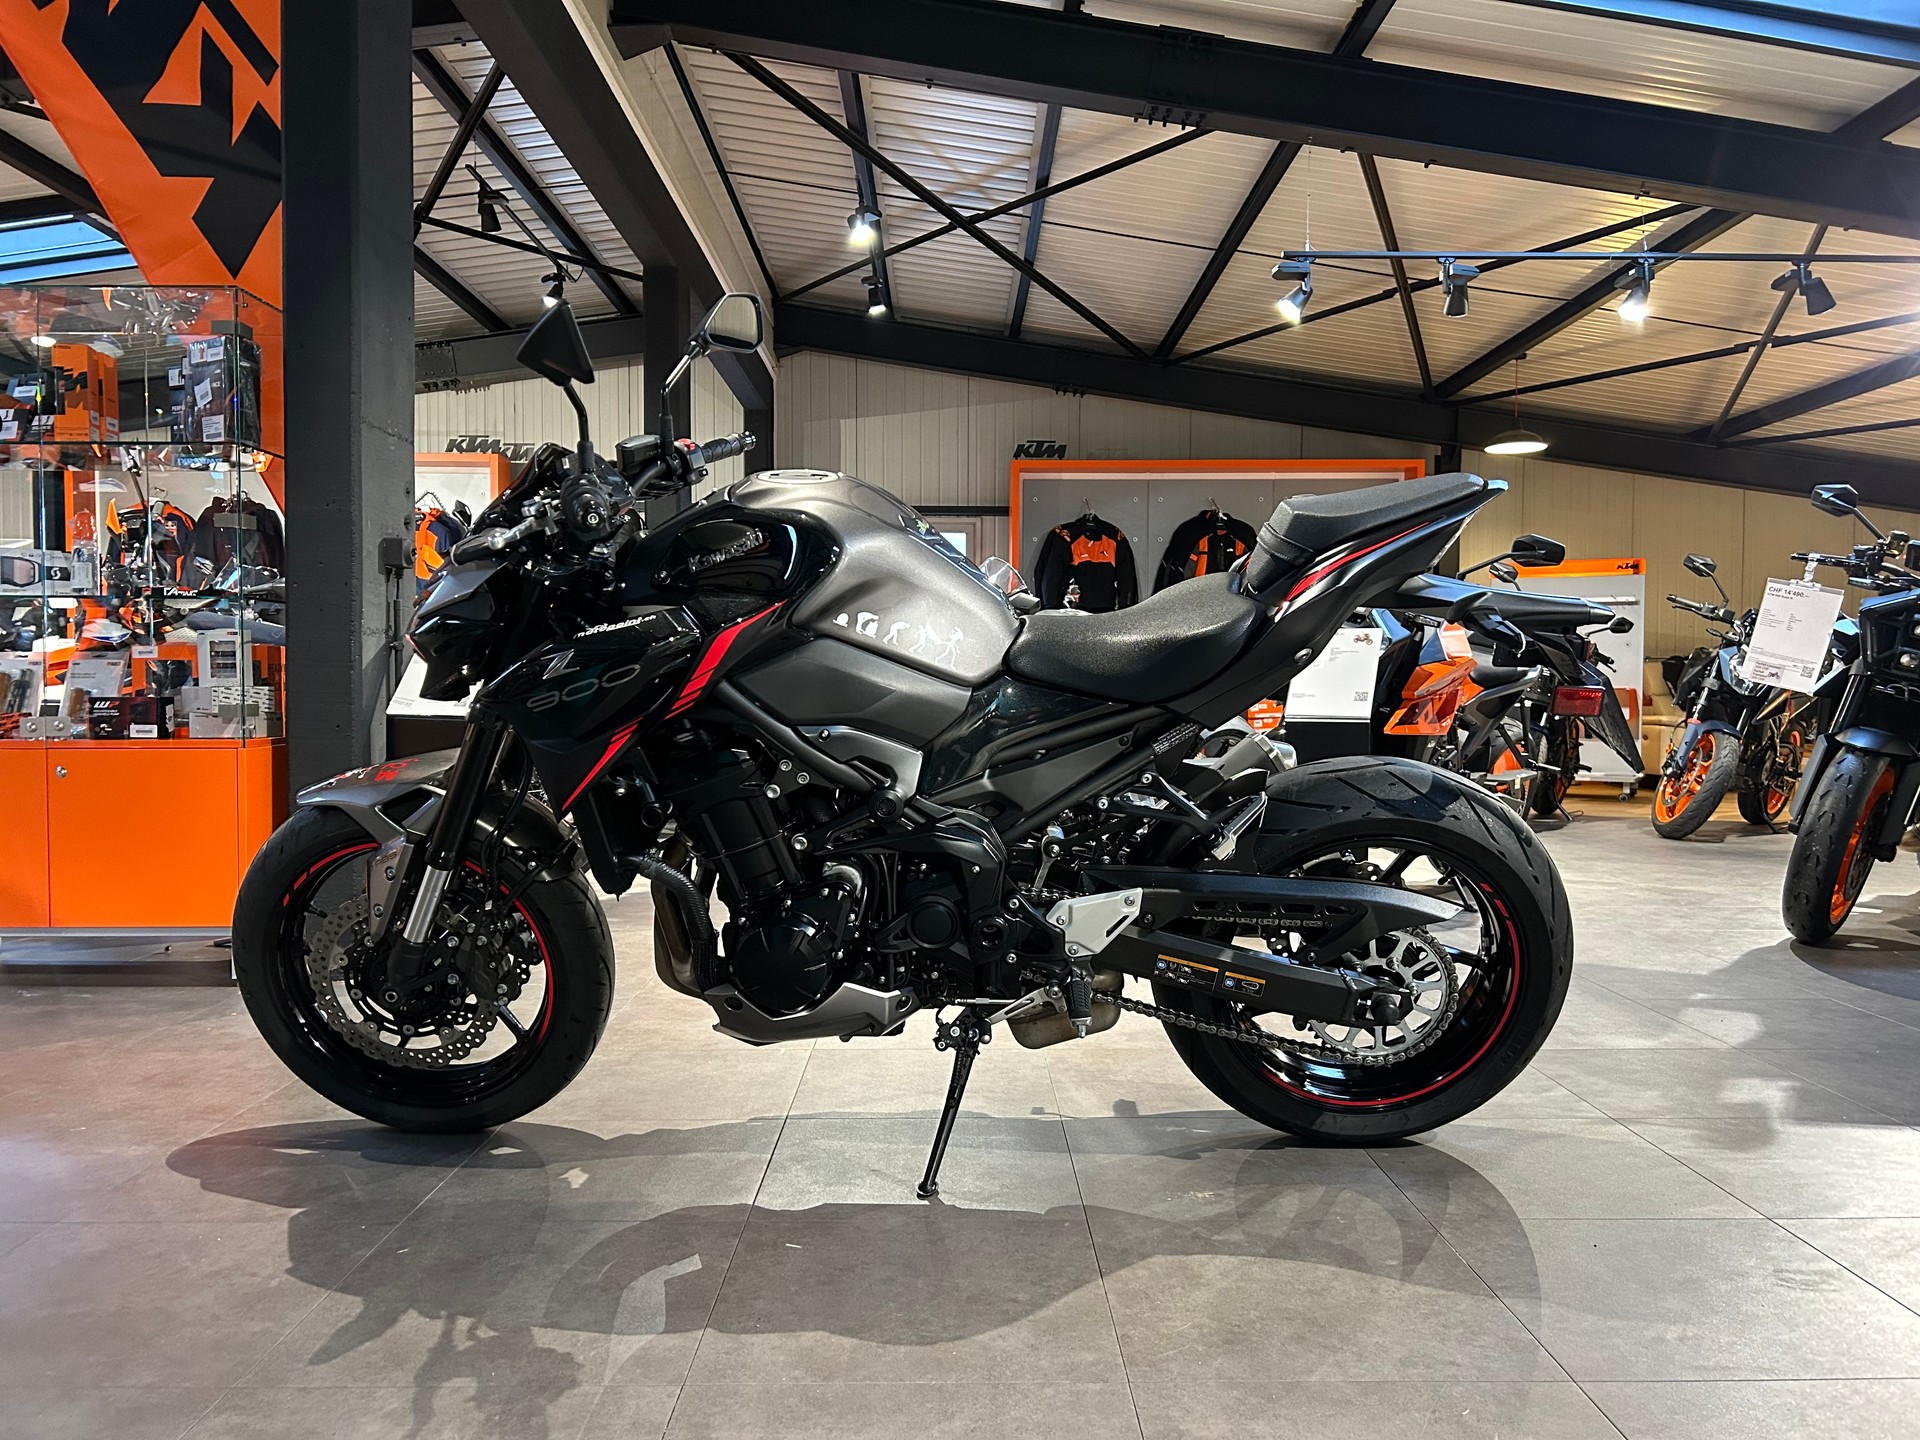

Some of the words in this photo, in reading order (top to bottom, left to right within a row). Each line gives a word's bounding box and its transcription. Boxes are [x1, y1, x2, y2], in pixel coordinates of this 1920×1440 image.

[445, 434, 501, 454] KTM
[1012, 439, 1068, 459] KTM
[687, 527, 764, 573] Kawasaki
[540, 648, 581, 681] Z
[525, 663, 641, 713] 900
[93, 701, 120, 709] WP
[375, 851, 398, 866] ABS
